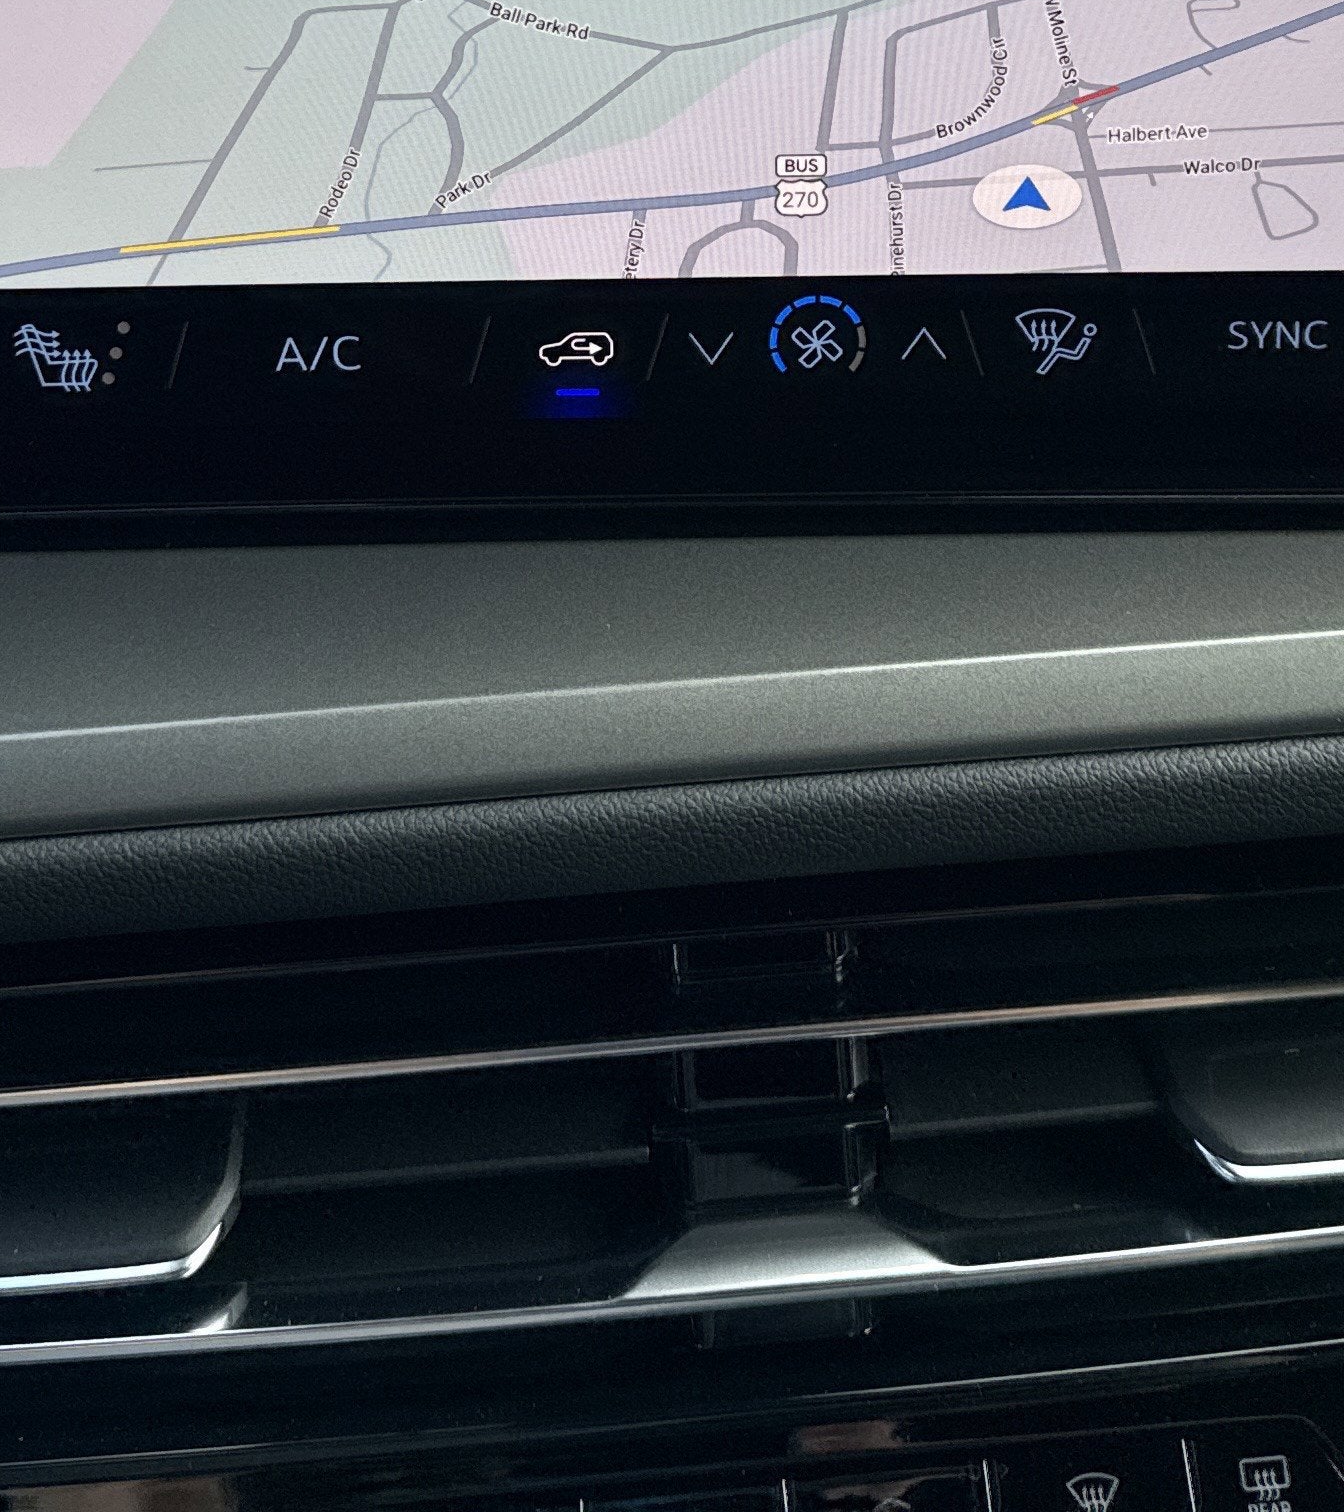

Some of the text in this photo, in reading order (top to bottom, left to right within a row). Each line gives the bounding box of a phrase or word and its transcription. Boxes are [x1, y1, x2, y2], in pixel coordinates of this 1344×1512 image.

[489, 1, 589, 41] Ball Park Rd
[1048, 9, 1071, 64] Moline
[1063, 68, 1077, 86] St
[936, 38, 1007, 138] Brownwood Cir
[1108, 125, 1207, 143] Halbert Ave
[319, 148, 361, 218] Rodeo Dr
[784, 159, 818, 173] BUS
[1184, 158, 1260, 175] Walco Dr
[435, 171, 492, 209] Park Dr
[782, 192, 819, 209] 270
[275, 335, 361, 372] A/C
[1226, 320, 1328, 350] SYNC
